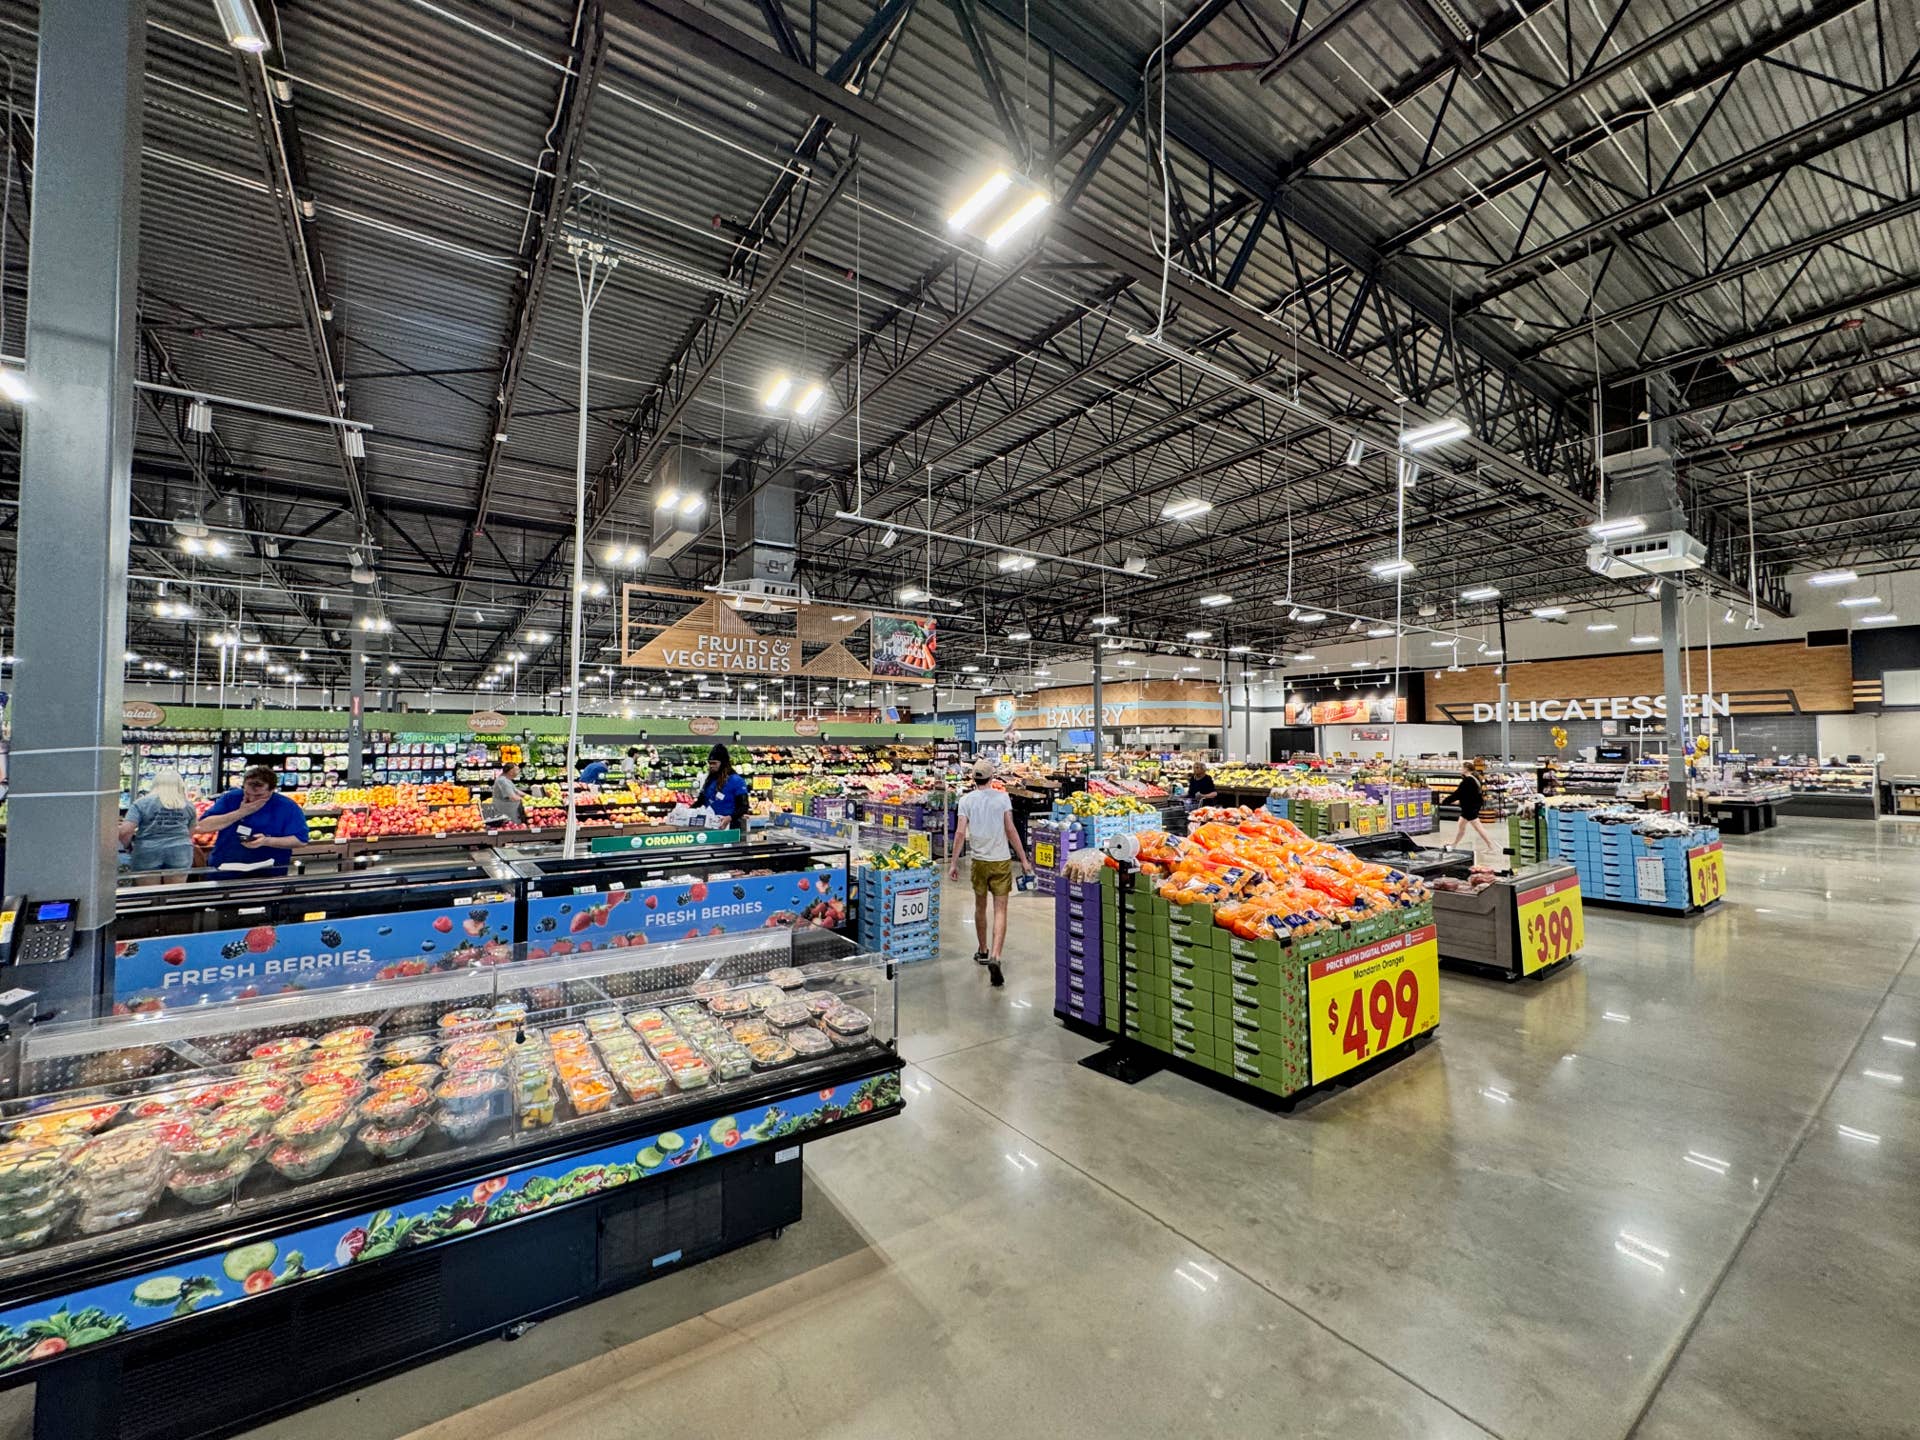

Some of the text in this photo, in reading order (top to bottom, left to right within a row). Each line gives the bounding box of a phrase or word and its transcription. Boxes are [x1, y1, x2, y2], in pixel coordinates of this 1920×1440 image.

[698, 634, 791, 656] FRUITS &
[662, 648, 790, 672] VEGETABLES
[470, 718, 505, 728] organic
[1046, 706, 1124, 728] BAKERY
[645, 834, 694, 846] ORGANIC
[645, 902, 762, 926] FRESH BERRIES
[902, 902, 924, 917] 5.00
[1326, 940, 1402, 972] PRICE WITH DIGITAL COUPON
[1354, 955, 1405, 980] Mandarin Oranges
[162, 948, 372, 990] FRESH BERRIES
